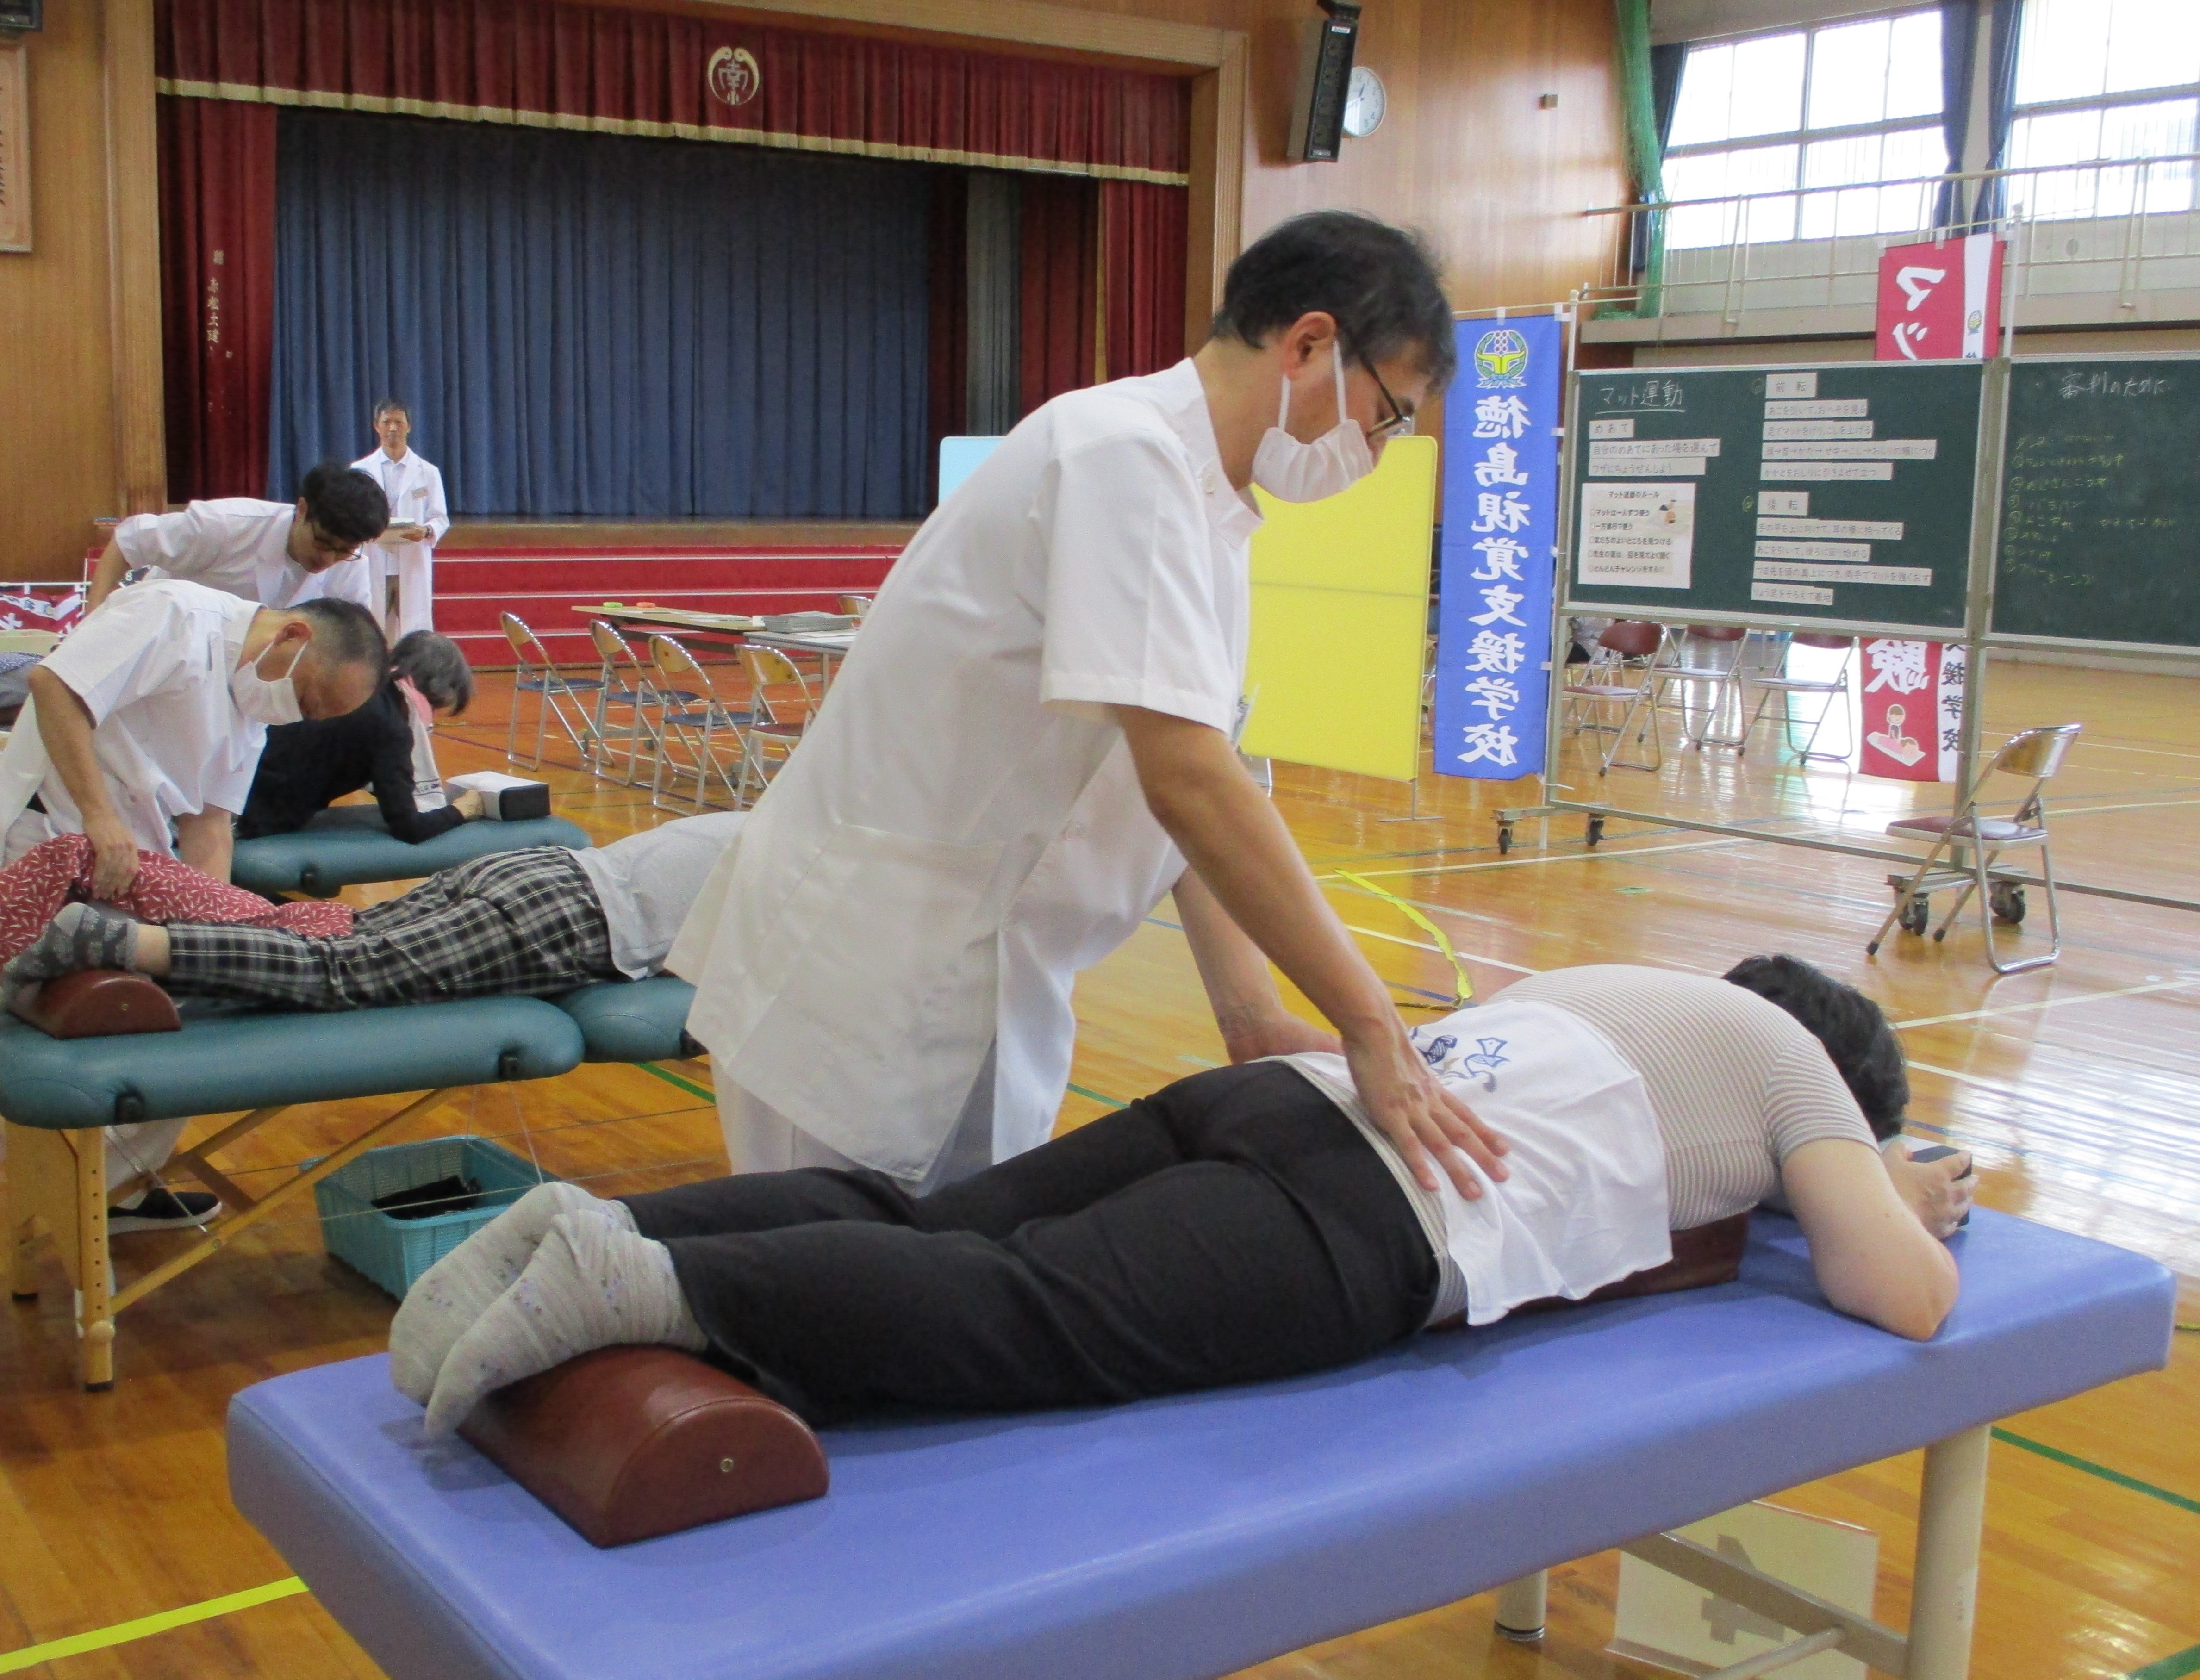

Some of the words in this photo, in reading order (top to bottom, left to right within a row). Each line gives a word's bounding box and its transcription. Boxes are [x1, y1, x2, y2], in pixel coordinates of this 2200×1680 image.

[1600, 380, 1683, 408] マット運動
